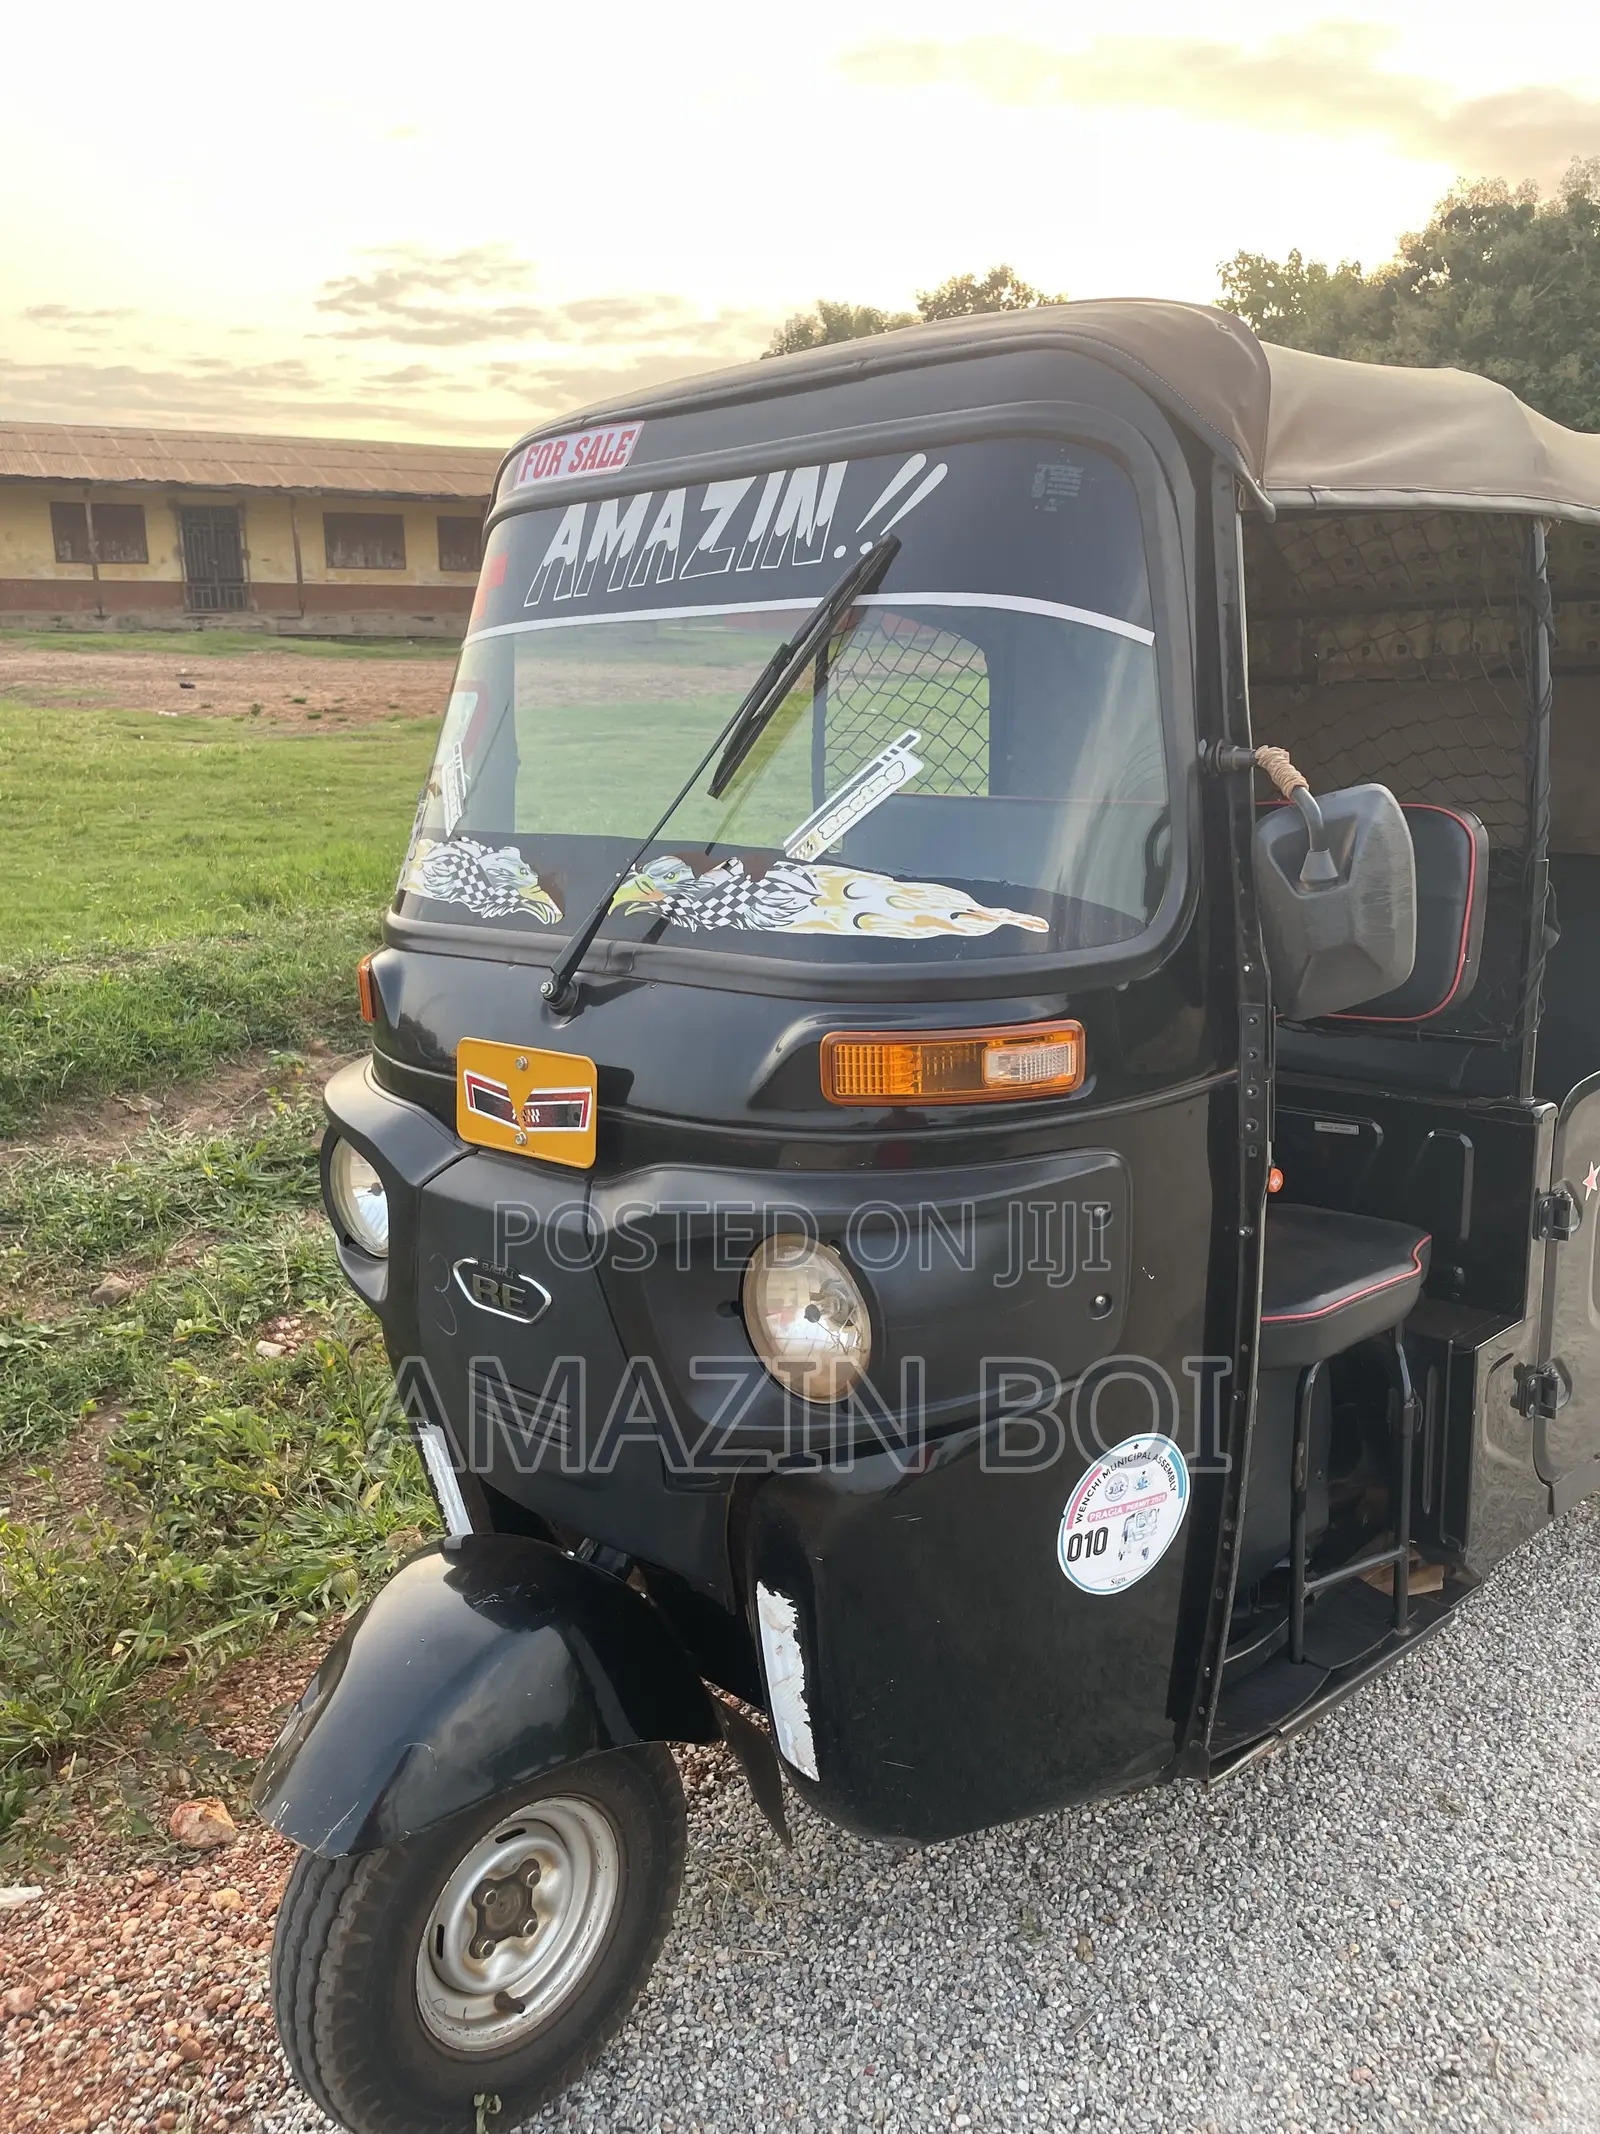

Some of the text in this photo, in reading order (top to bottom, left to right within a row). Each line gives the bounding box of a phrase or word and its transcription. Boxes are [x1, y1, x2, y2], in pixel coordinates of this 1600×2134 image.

[519, 429, 637, 482] FOR SALE
[472, 1273, 528, 1315] RE
[1075, 1451, 1176, 1524] WENCHI MUNICIPAL ASSEMBLY
[1089, 1506, 1124, 1522] PRAGIA
[1066, 1526, 1109, 1563] 010
